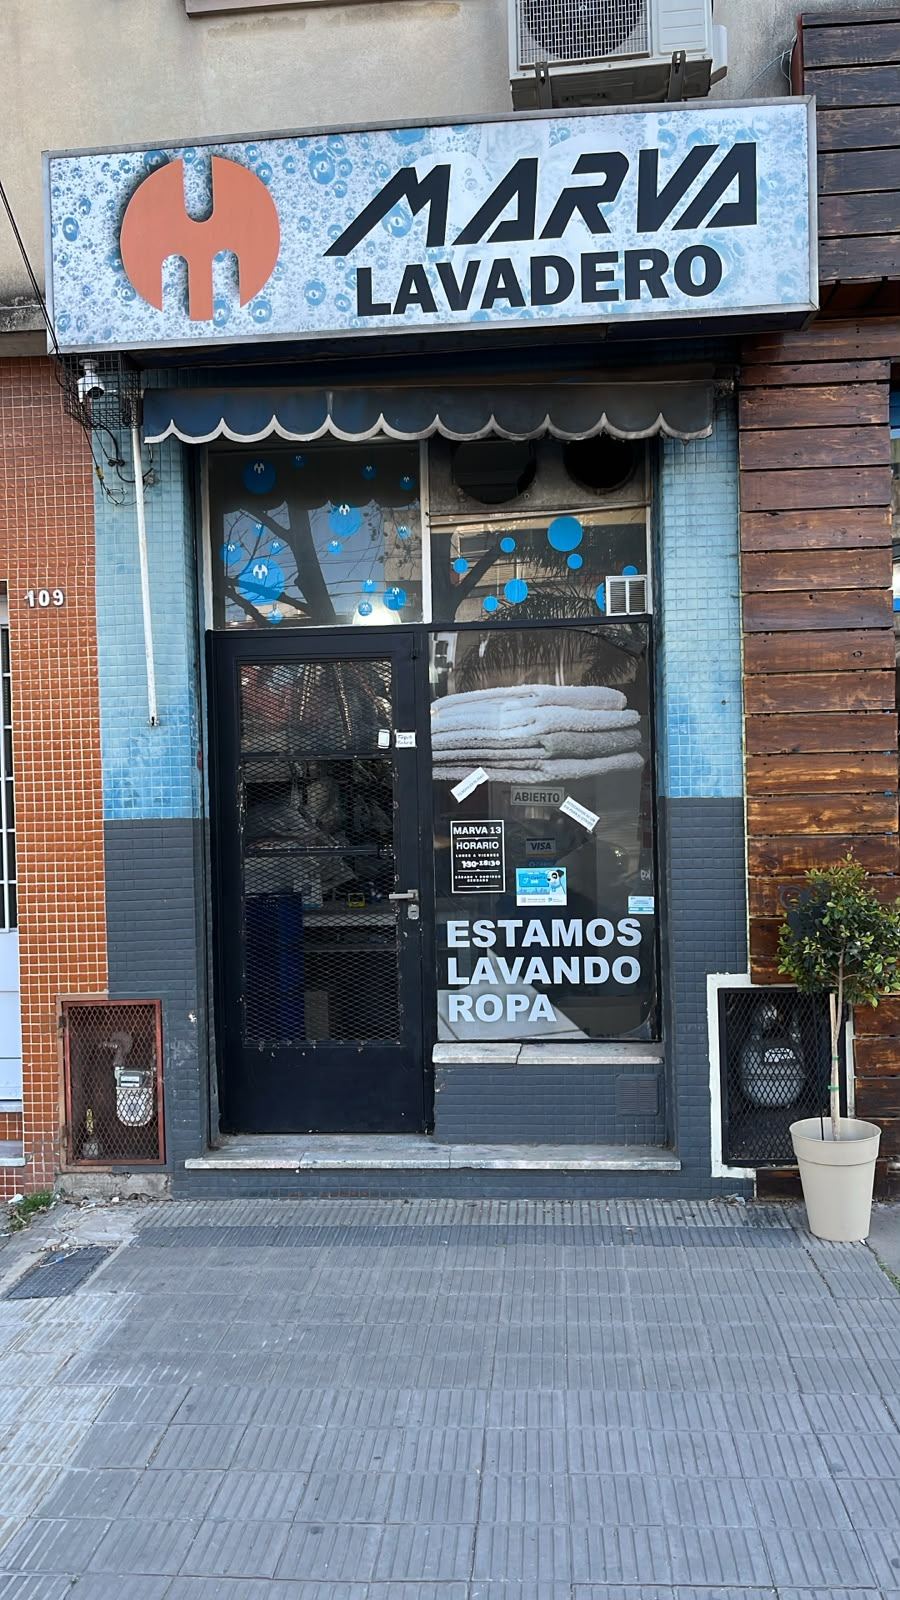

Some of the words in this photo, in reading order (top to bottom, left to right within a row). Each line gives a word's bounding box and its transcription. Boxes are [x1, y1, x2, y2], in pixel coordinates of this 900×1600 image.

[321, 141, 759, 257] MARVA
[355, 244, 723, 317] LAVADERO
[24, 588, 64, 608] 109
[514, 791, 560, 803] ABIERTO
[453, 826, 488, 835] MARVA
[489, 826, 502, 834] 13
[456, 841, 499, 850] HORARIO
[530, 842, 552, 850] VISA
[446, 918, 643, 948] ESTAMOS
[447, 955, 641, 986] LAVANDO
[448, 994, 557, 1024] ROPA
